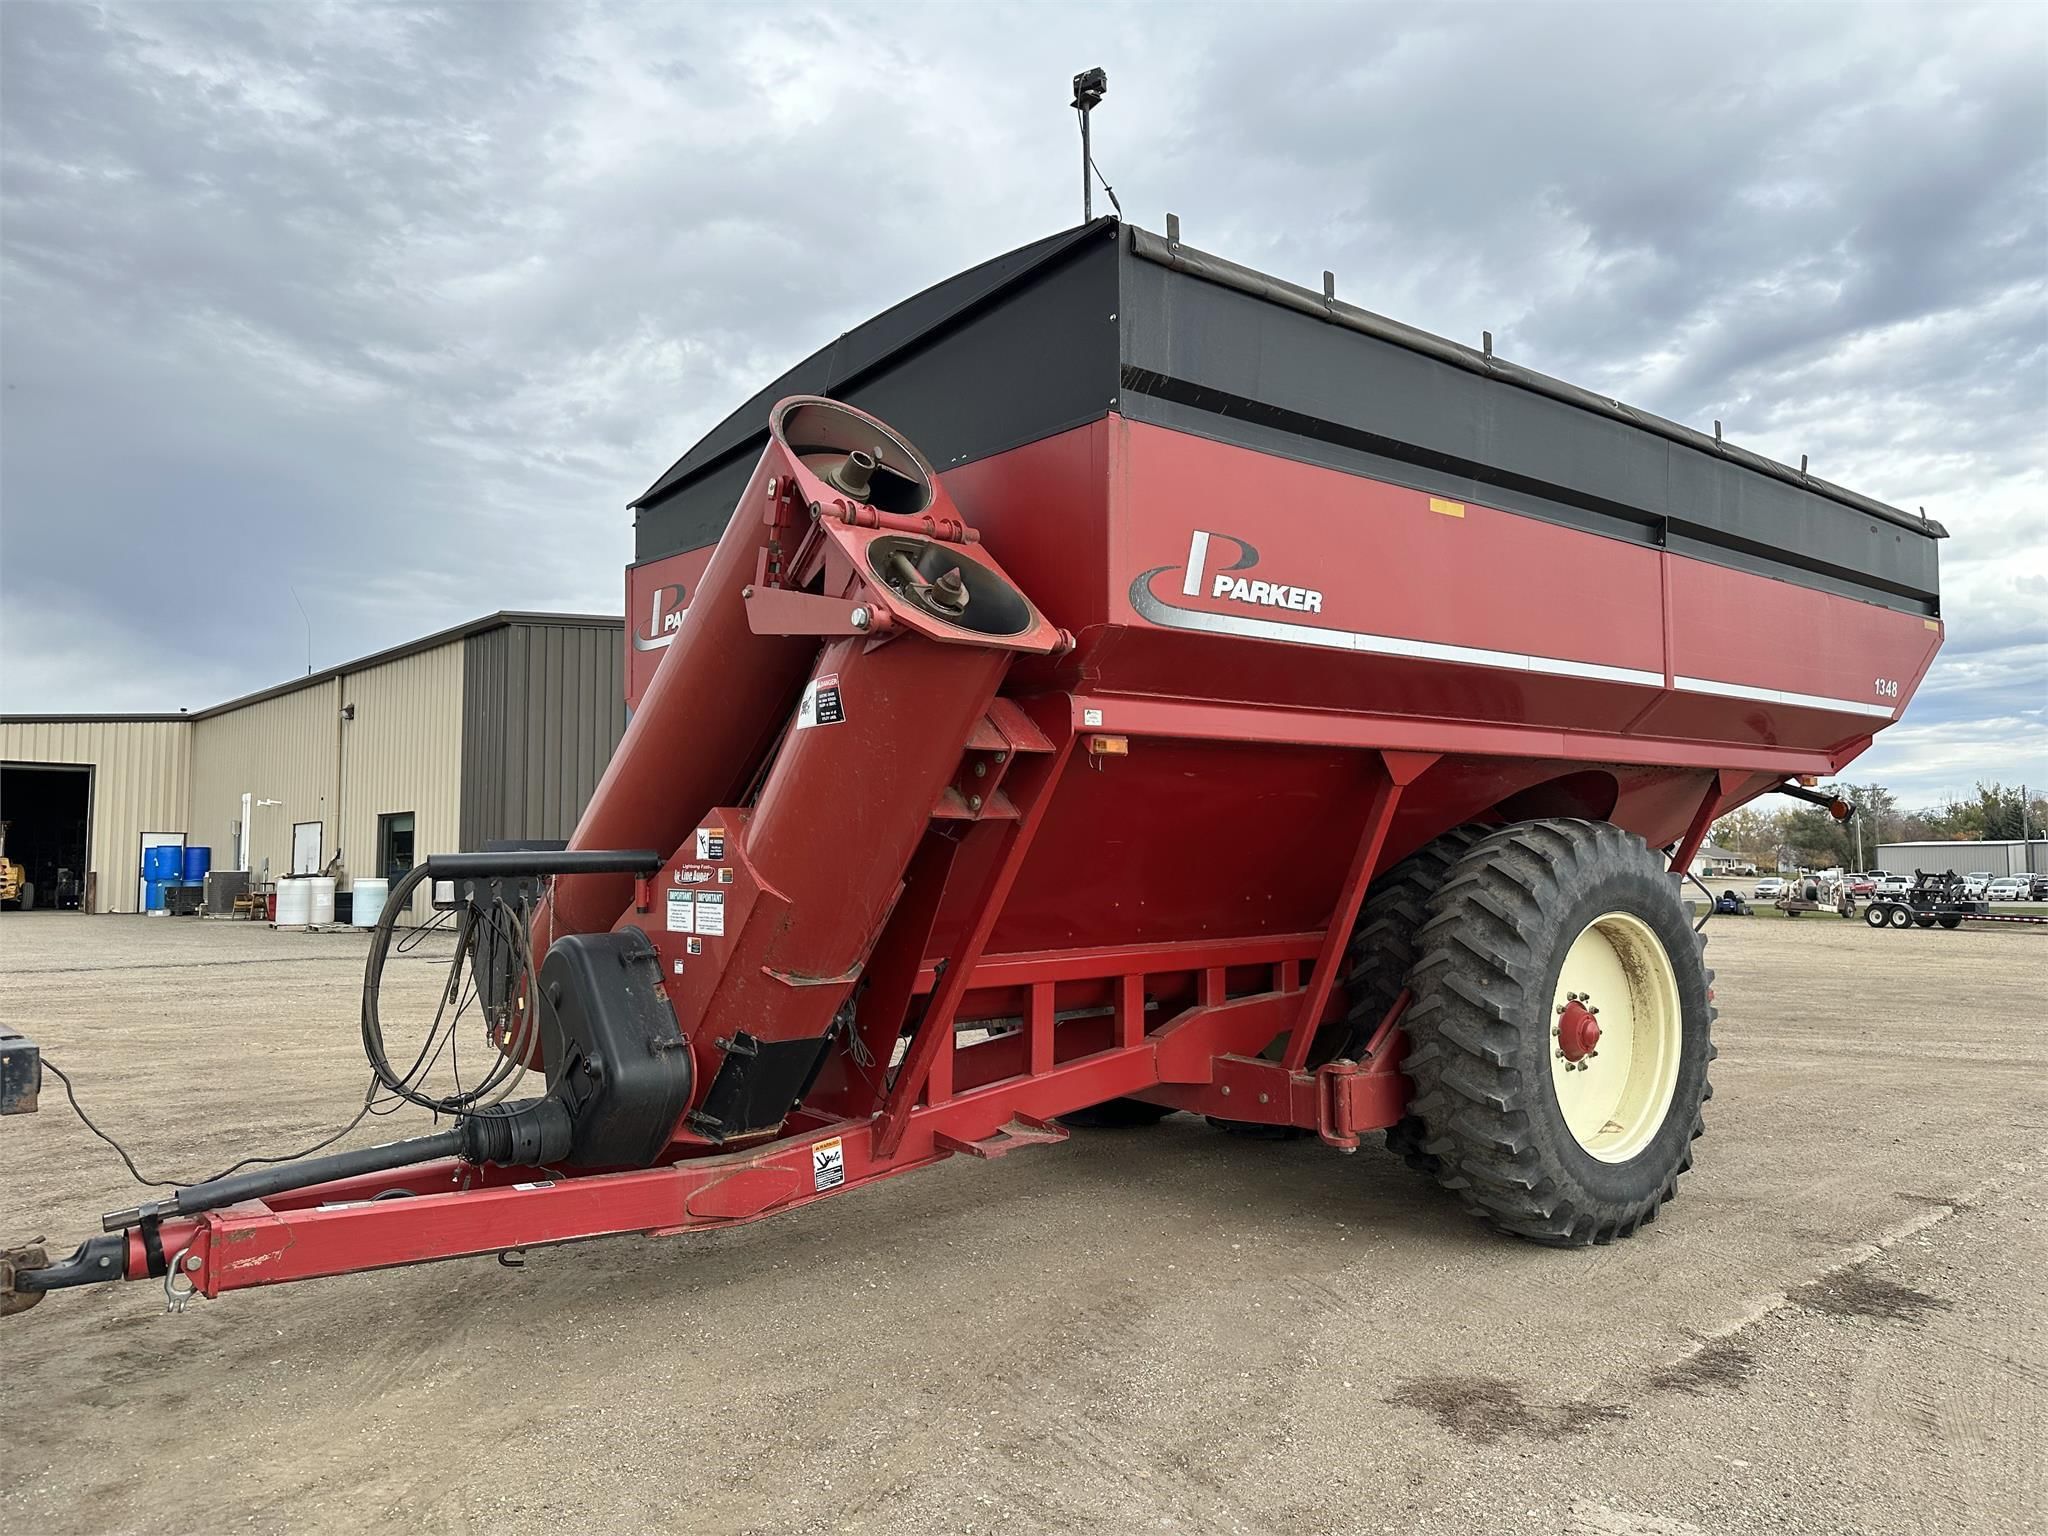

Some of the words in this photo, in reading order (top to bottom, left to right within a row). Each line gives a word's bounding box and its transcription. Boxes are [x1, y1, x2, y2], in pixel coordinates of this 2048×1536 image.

[1212, 574, 1322, 614] PARKER
[820, 678, 838, 687] DANGER
[1874, 678, 1898, 698] 1348
[669, 891, 692, 901] IMPORTANT
[697, 893, 722, 903] IMPORTANT
